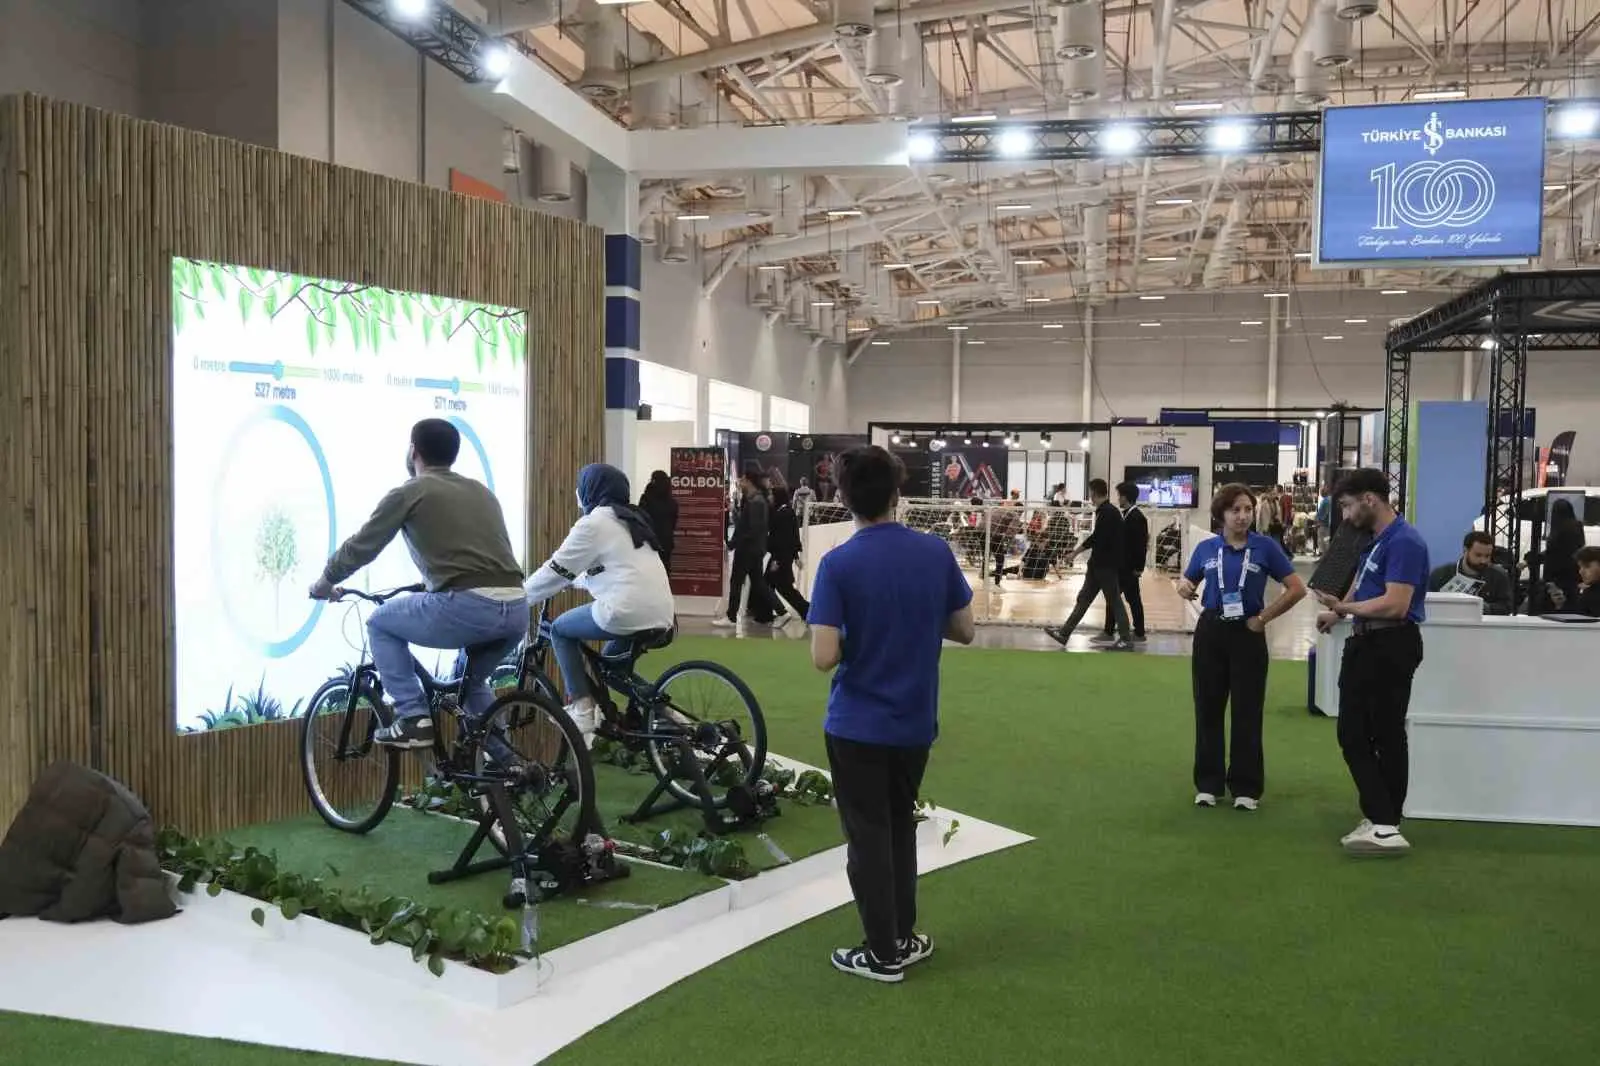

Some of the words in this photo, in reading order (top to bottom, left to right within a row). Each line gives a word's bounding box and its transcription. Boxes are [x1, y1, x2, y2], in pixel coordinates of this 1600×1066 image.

[1361, 128, 1421, 143] TÜRKİYE
[1445, 126, 1506, 139] BANKASI
[1371, 159, 1495, 229] 100
[201, 359, 226, 371] metre
[255, 382, 271, 398] 527
[273, 384, 296, 400] metre
[434, 395, 447, 411] 571
[448, 399, 467, 411] metre
[671, 475, 724, 488] GOLBOL
